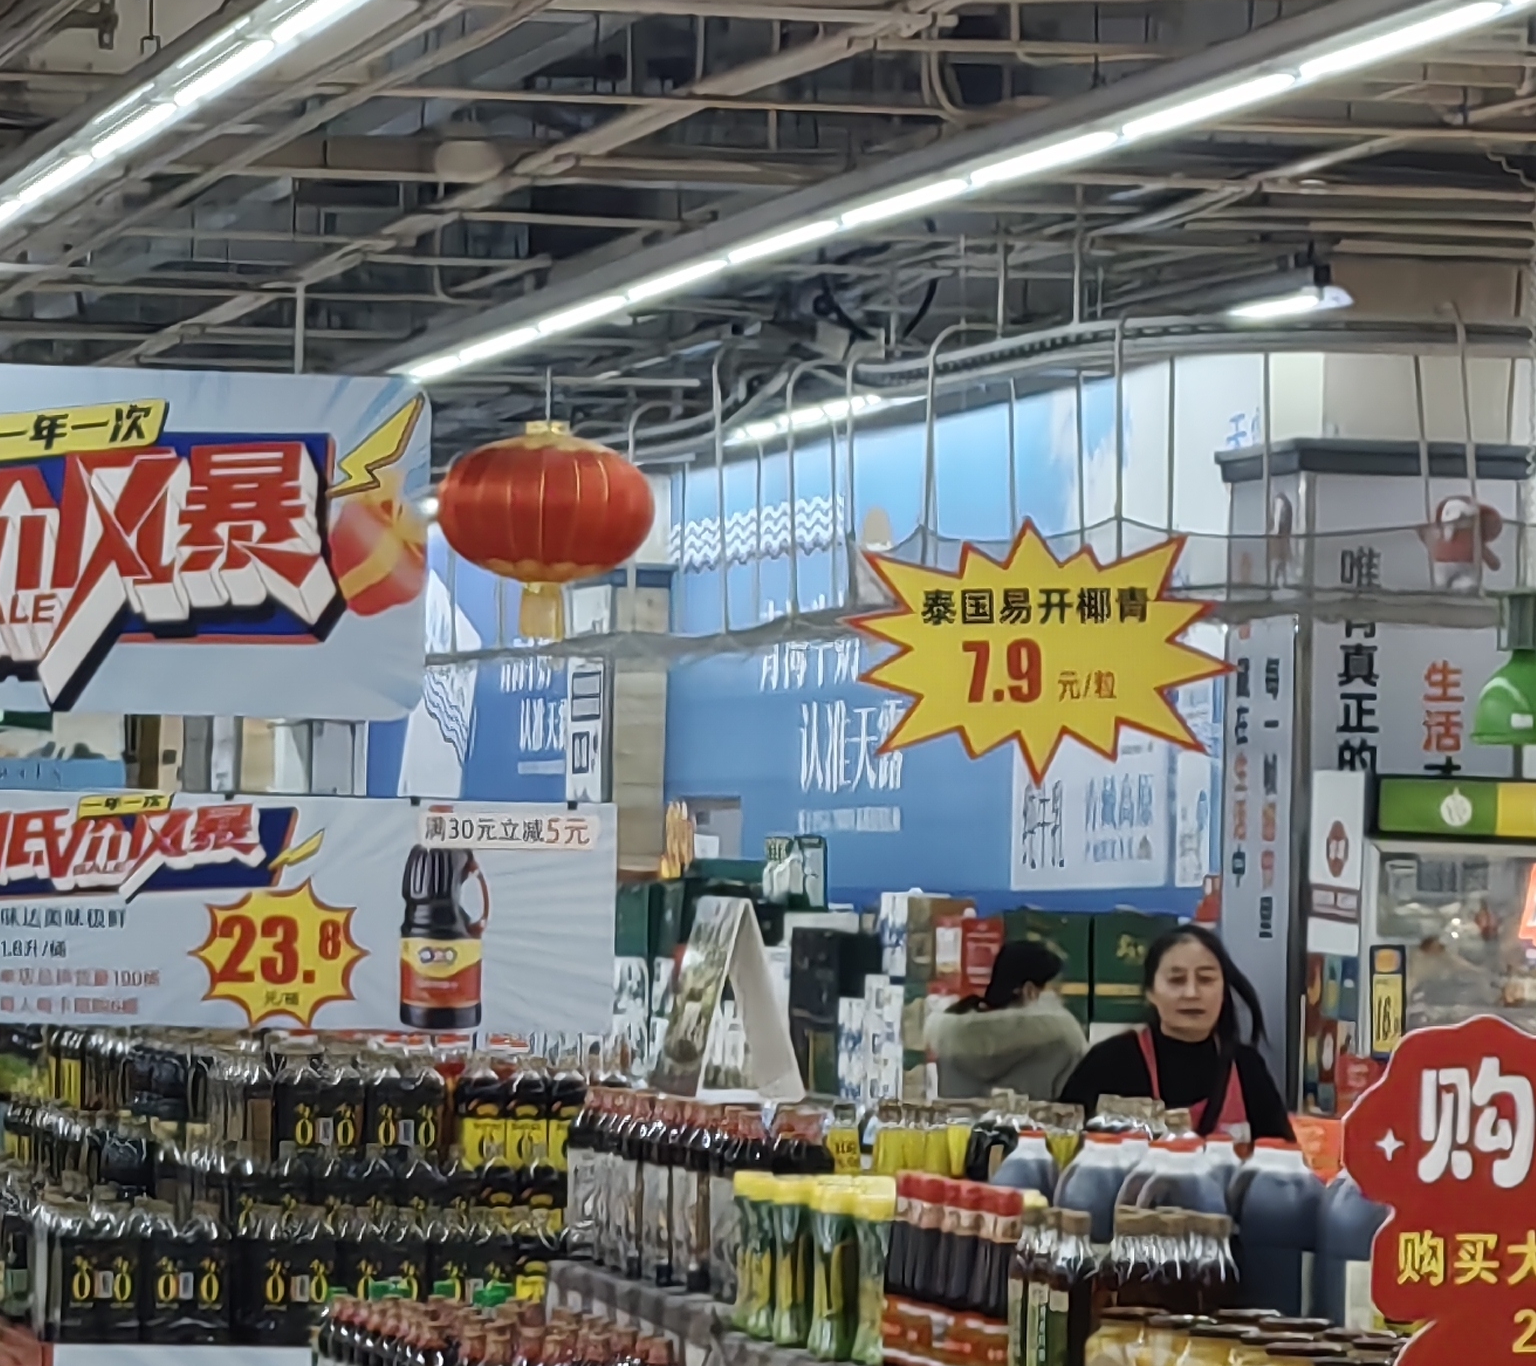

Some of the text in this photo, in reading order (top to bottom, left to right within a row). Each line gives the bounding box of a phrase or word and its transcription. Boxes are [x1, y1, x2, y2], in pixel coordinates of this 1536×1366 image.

[920, 586, 1149, 625] 泰国易开椰青
[962, 637, 1043, 704] 7.9
[424, 816, 591, 845] 满30元立减5元
[216, 913, 343, 986] 23.8
[1417, 1056, 1534, 1188] 购
